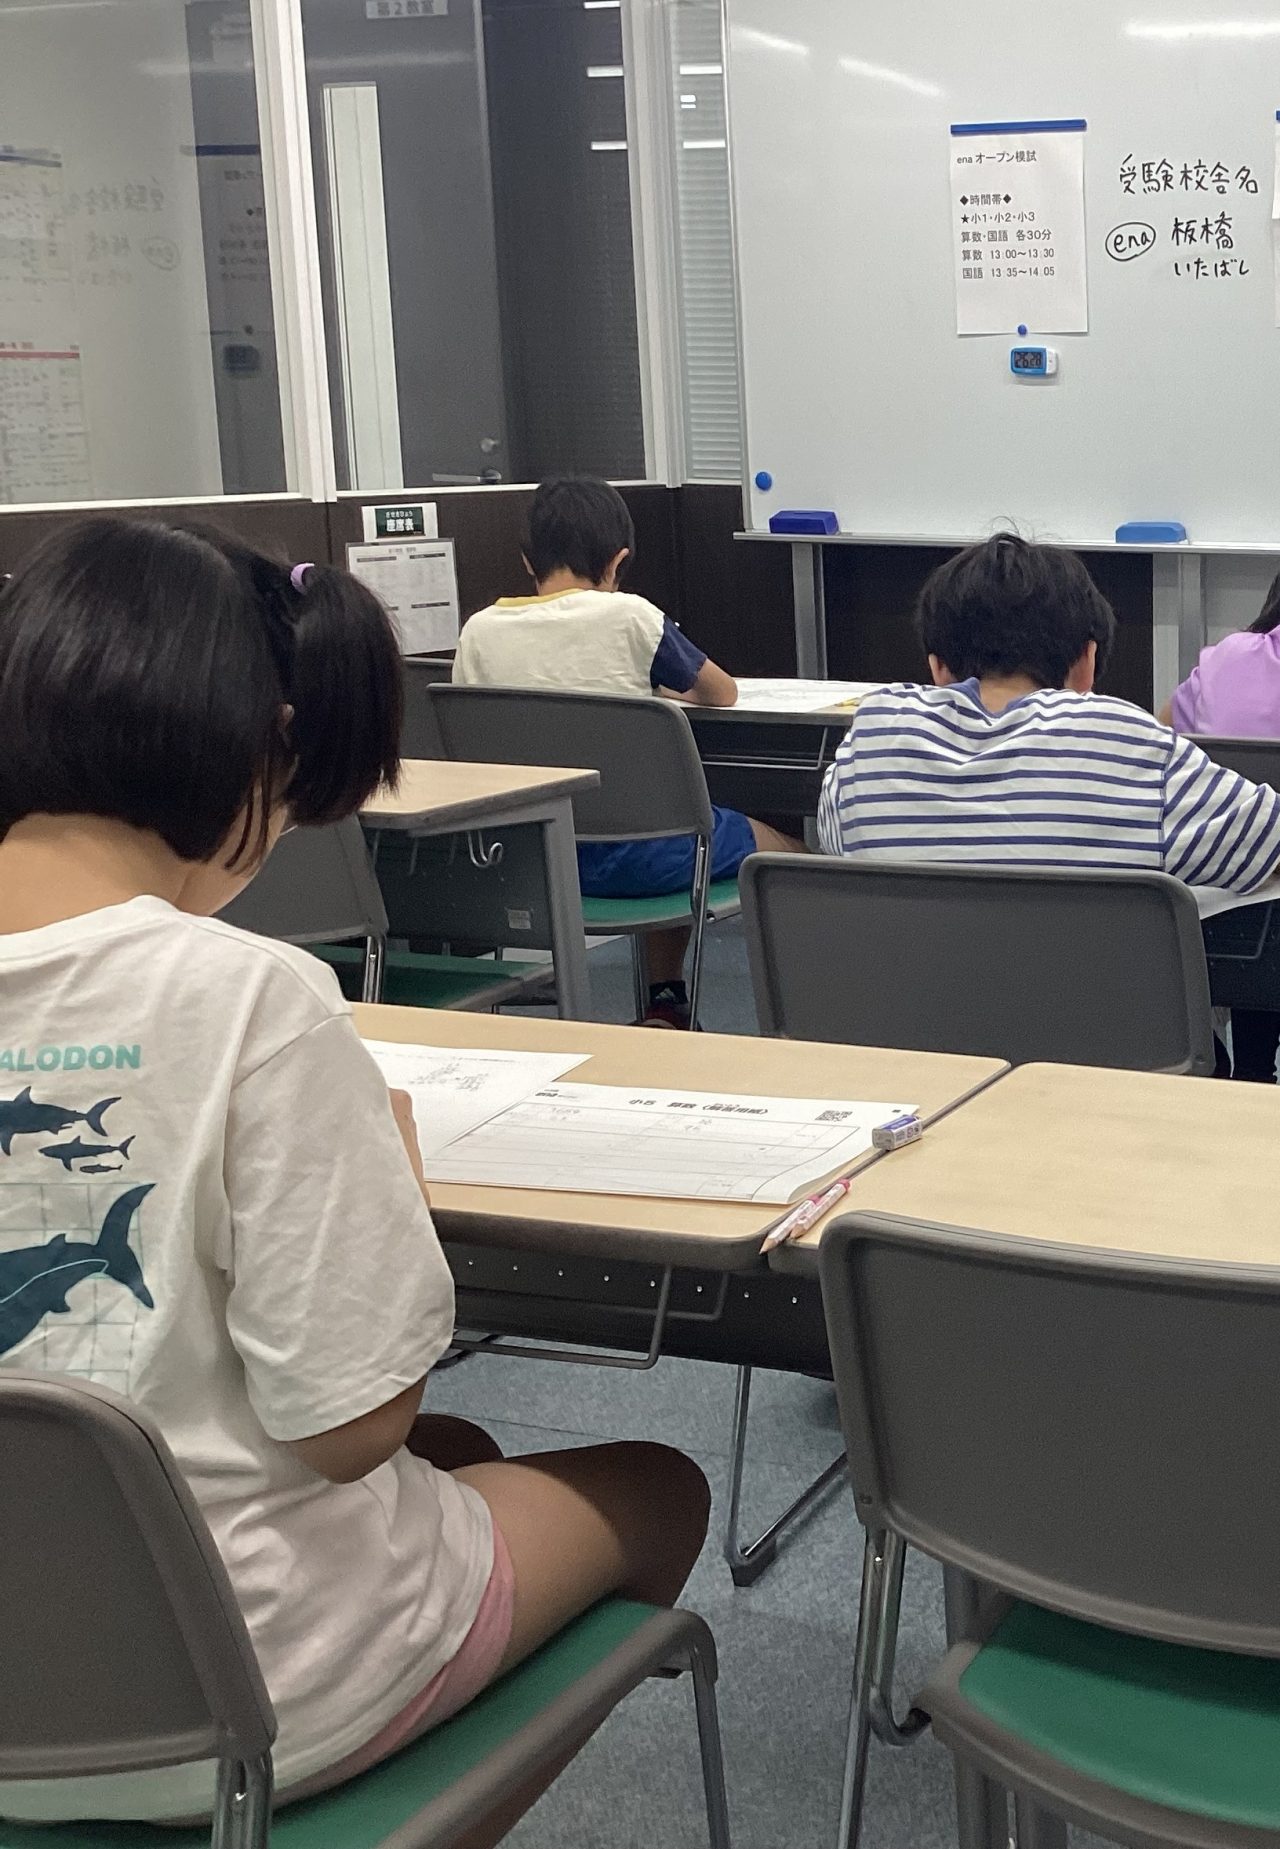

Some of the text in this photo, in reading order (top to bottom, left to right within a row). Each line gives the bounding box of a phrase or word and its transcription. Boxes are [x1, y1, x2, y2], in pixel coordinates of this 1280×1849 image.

[956, 150, 1037, 164] ena オープン模試
[1119, 153, 1259, 195] 受験校舎名
[969, 194, 1002, 206] 時間帯
[961, 229, 1052, 243] 算数・国語 各30分
[1171, 211, 1234, 250] 板橋
[962, 249, 983, 261] 算数
[962, 267, 983, 279] 国語
[1174, 257, 1250, 280] いたばし
